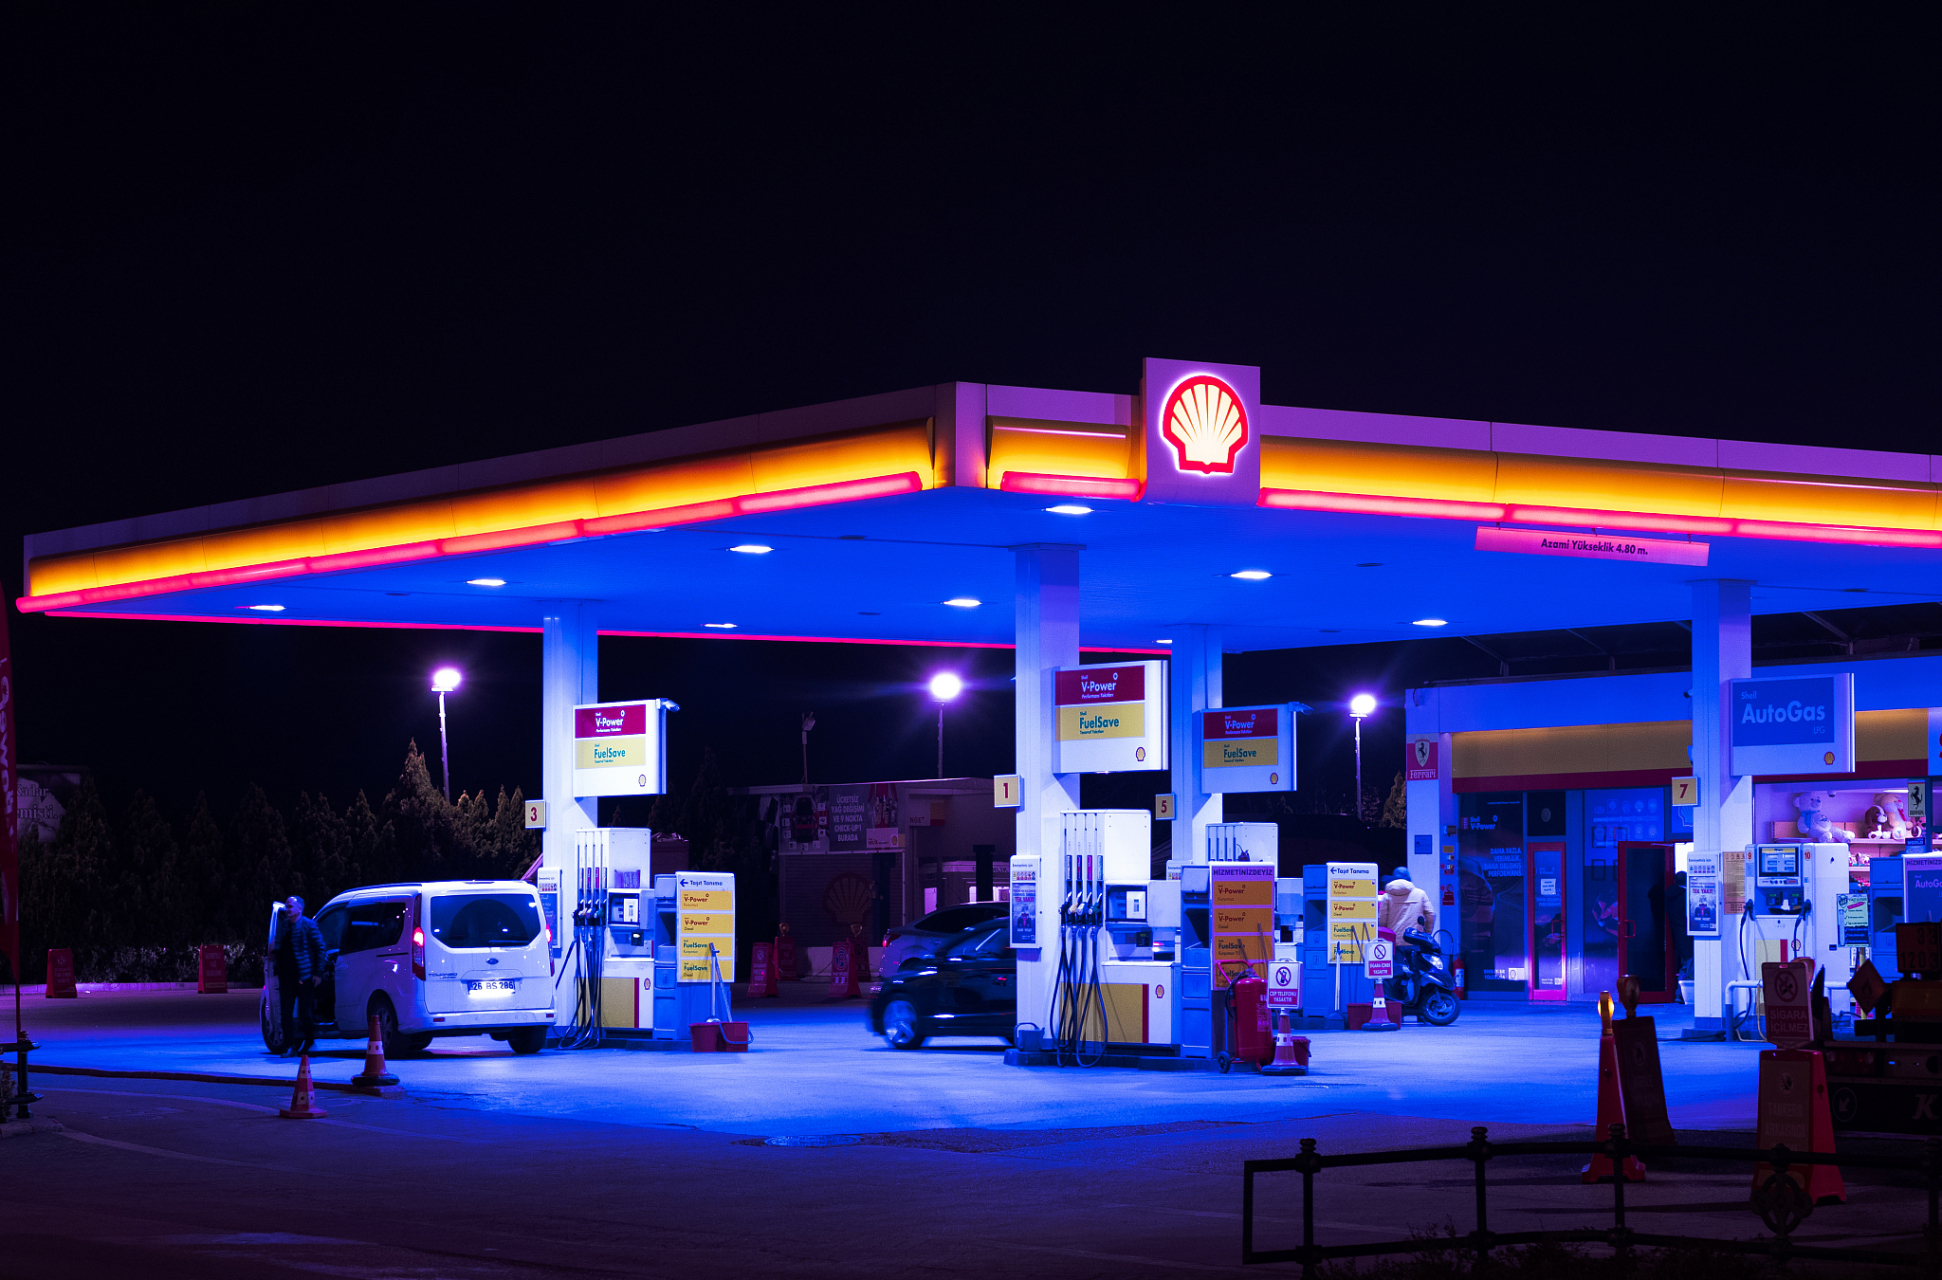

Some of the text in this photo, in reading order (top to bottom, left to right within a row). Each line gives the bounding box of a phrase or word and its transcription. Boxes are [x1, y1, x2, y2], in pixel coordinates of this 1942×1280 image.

[1541, 539, 1649, 556] Azami Yükseklik 4.80 m.
[1081, 681, 1117, 692] V-Power
[1741, 691, 1757, 700] Shell
[1741, 700, 1826, 724] AutoGas
[595, 717, 624, 728] V-Power
[1080, 715, 1120, 729] FuelSave
[1224, 720, 1255, 730] V-Power
[1813, 726, 1826, 734] LPG
[594, 747, 626, 759] FuelSave
[1224, 748, 1257, 759] FuelSave
[1410, 769, 1436, 779] Ferrari
[1003, 783, 1009, 799] 1
[1679, 784, 1689, 799] 7
[837, 794, 859, 804] ÜCRETSİZ
[831, 804, 843, 814] YAĞ
[1160, 800, 1167, 813] 5
[530, 806, 538, 822] 3
[833, 815, 840, 823] VE
[845, 815, 863, 824] NOKTA
[837, 834, 858, 842] BURADA
[1747, 851, 1753, 860] 9
[1804, 851, 1812, 860] 10
[1213, 868, 1273, 876] HİZMETİNİZDEYİZ
[1218, 887, 1245, 895] V-Power
[1218, 915, 1245, 923] V-Power
[1917, 927, 1937, 945] 33
[1900, 951, 1937, 969] 1203
[472, 982, 483, 990] 26
[499, 981, 514, 990] 286
[1770, 1008, 1808, 1020] SİGARA
[1770, 1021, 1809, 1035] İÇİLMEZ
